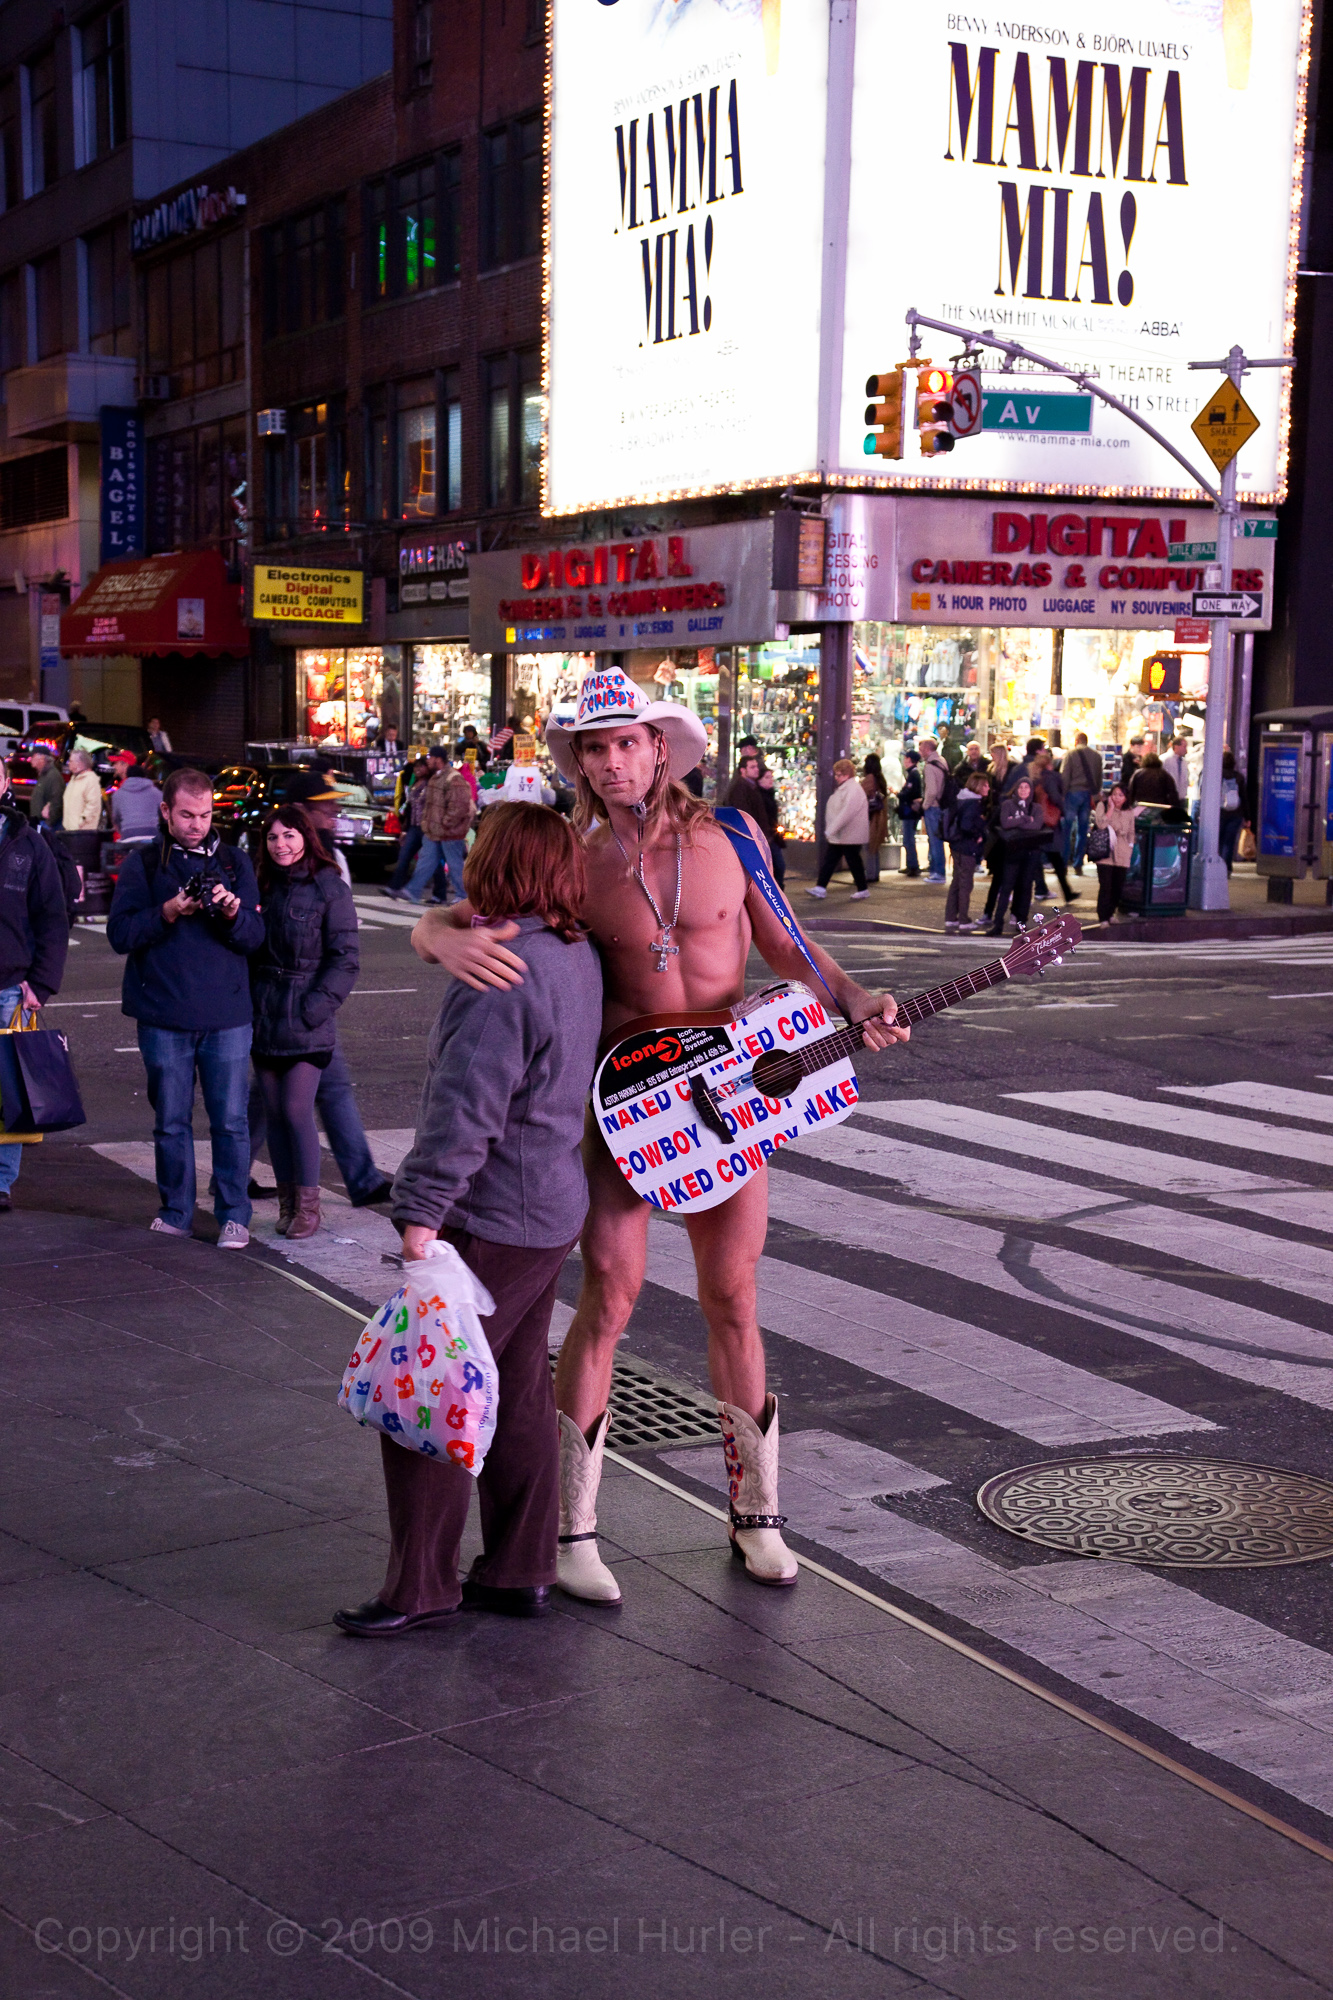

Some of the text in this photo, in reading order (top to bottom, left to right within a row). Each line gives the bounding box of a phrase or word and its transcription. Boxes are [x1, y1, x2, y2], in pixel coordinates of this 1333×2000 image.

[947, 13, 989, 34] BENNY
[994, 21, 1070, 46] ANDERSSON
[1076, 32, 1086, 49] &
[1093, 32, 1134, 55] BJÖRN
[944, 41, 1189, 186] MAMMA
[613, 78, 744, 235] MAMMA
[994, 181, 1137, 307] MIA!
[638, 214, 714, 348] MIA!
[941, 303, 965, 321] THE
[969, 306, 1013, 325] SMASH
[1017, 309, 1037, 327] HIT
[1042, 313, 1094, 332] MUSICAL
[978, 354, 1036, 373] WINER
[1109, 364, 1172, 384] THEATRE
[998, 399, 1041, 424] Av
[1146, 395, 1200, 413] STREET
[1210, 427, 1237, 437] SHARE
[1212, 448, 1233, 458] ROAD
[521, 536, 694, 590] DIGITAL
[267, 569, 351, 584] Electronics
[911, 558, 1265, 592] CAMERAS & COMPUTRS
[286, 582, 333, 595] Digital
[817, 592, 860, 607] PHOTO
[260, 593, 357, 608] CAMERAS COMPUTERS
[952, 595, 984, 611] HOUR
[989, 596, 1027, 612] PHOTO
[1043, 598, 1096, 614] LUGGAGE
[1111, 600, 1127, 614] NY
[1132, 600, 1192, 616] SOUVENIRS
[1201, 599, 1252, 611] ONE WAY
[272, 606, 344, 620] LUGGAGE
[687, 616, 724, 633] GALLERY
[581, 674, 625, 695] NAKED
[579, 690, 634, 720] COWBOY
[518, 784, 534, 792] NY
[755, 869, 784, 918] NAKED
[677, 1028, 694, 1039] Icon
[680, 1031, 707, 1046] Parking
[684, 1035, 714, 1052] Systems
[611, 1043, 658, 1071] icon
[603, 1094, 620, 1107] ASTOR
[618, 1085, 638, 1100] PARKING
[636, 1080, 646, 1093] LLC
[602, 1089, 672, 1135] NAKED
[615, 1123, 702, 1181] COWBOY
